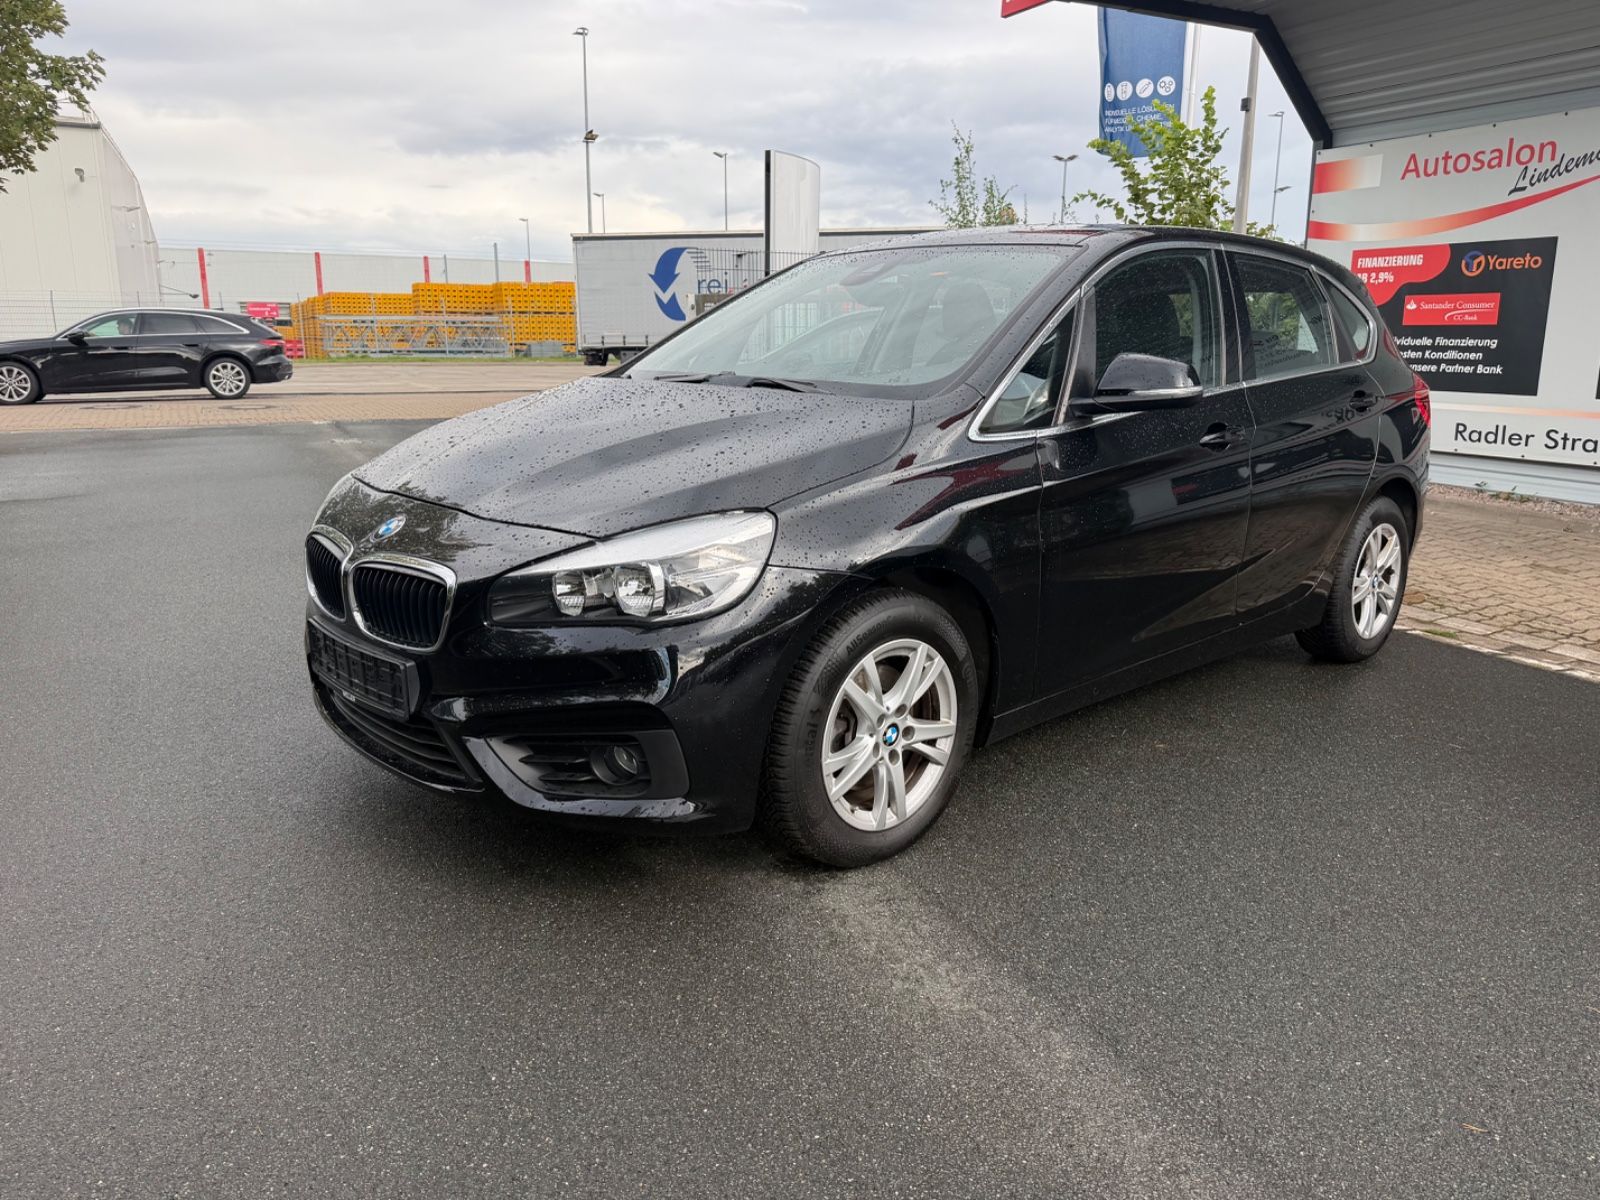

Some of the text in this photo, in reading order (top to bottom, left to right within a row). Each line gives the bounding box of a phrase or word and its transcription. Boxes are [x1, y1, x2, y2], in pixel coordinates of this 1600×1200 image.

[1400, 137, 1557, 181] Autosalon
[1357, 254, 1424, 269] FINANZIERUNG
[1487, 252, 1542, 271] Yareto
[1370, 271, 1394, 284] 2,9%
[1420, 300, 1495, 309] Santander Consumer
[1434, 336, 1498, 349] Finanzierung
[1424, 350, 1483, 360] Konditionen
[1439, 363, 1474, 373] Partner
[1476, 364, 1504, 375] Bank
[1454, 422, 1599, 454] Radler Stra
